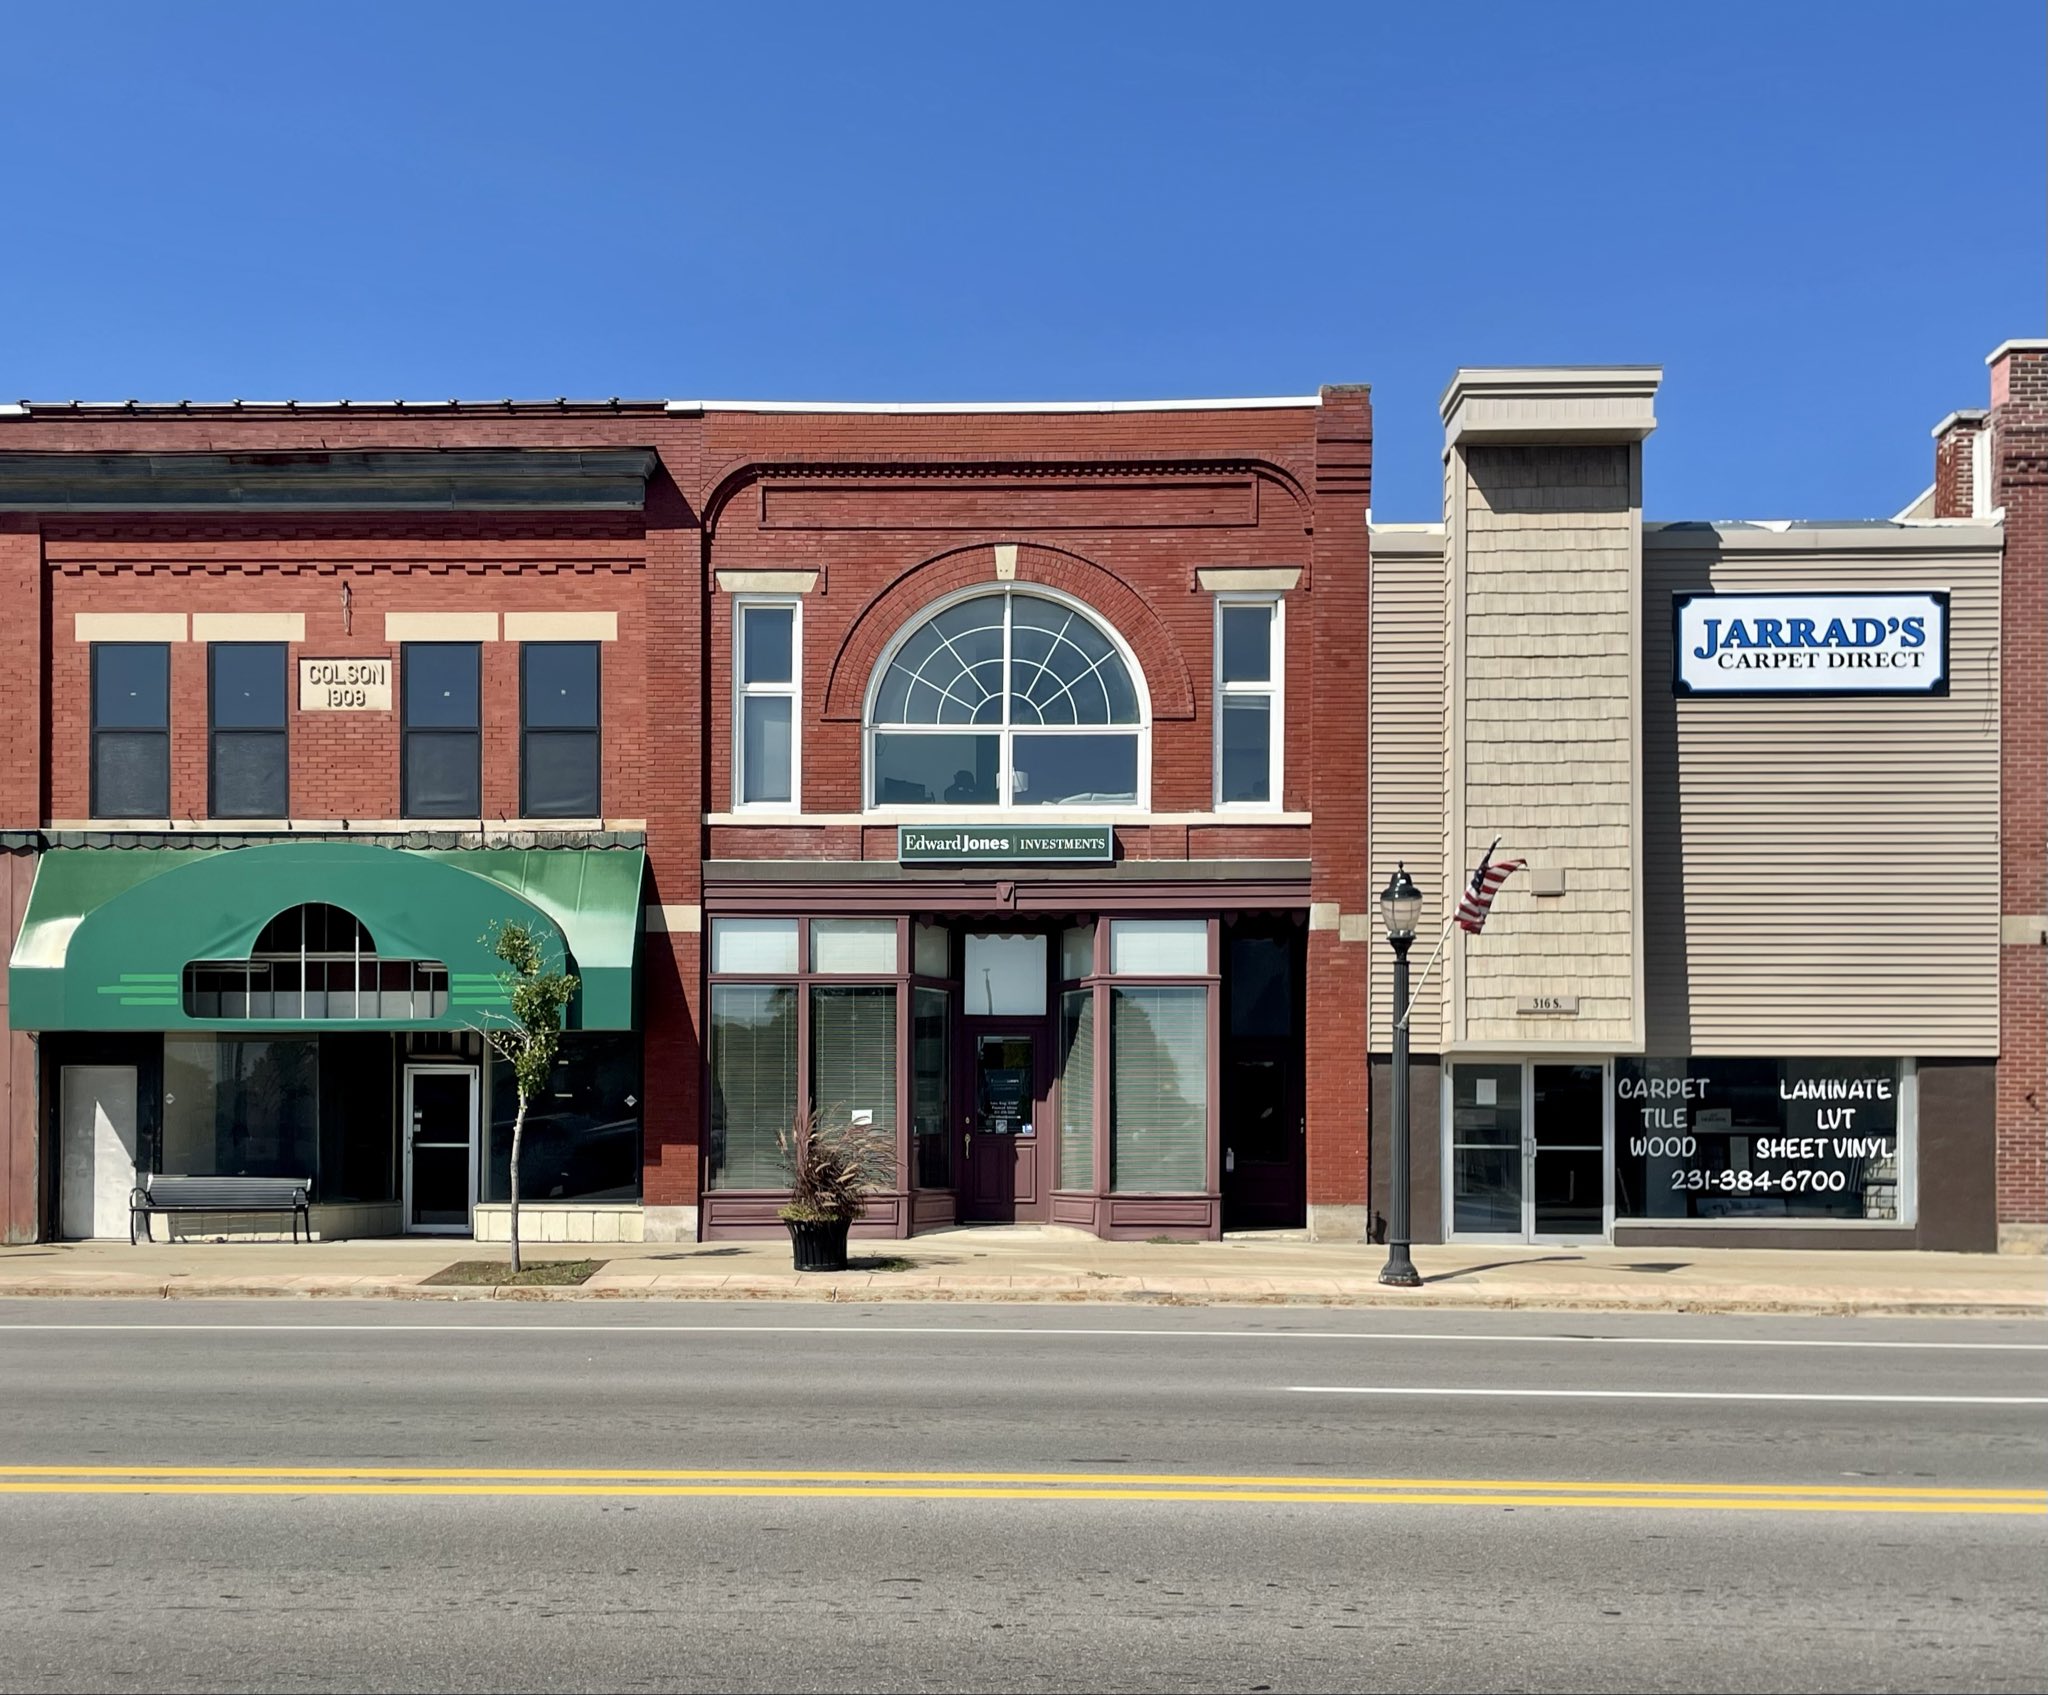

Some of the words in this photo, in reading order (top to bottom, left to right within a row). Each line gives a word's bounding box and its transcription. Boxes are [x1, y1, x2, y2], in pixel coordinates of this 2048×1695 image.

[1694, 617, 1926, 659] JARRAD'S
[1717, 651, 1819, 669] CARPET
[1828, 651, 1925, 669] DIRECT
[309, 664, 385, 685] COLSON
[327, 688, 366, 707] 1908
[1020, 838, 1106, 850] INVESTMENTS
[1533, 997, 1551, 1009] 316
[1553, 997, 1562, 1009] S.
[1618, 1078, 1710, 1099] CARPET
[1780, 1078, 1892, 1100] LAMINATE
[1640, 1107, 1688, 1128] TILE
[1817, 1107, 1856, 1129] LVT
[1630, 1136, 1697, 1158] WOOD
[1756, 1137, 1829, 1159] SHEET
[1832, 1137, 1894, 1160] VINYL
[1671, 1169, 1846, 1192] 231-384-6700
